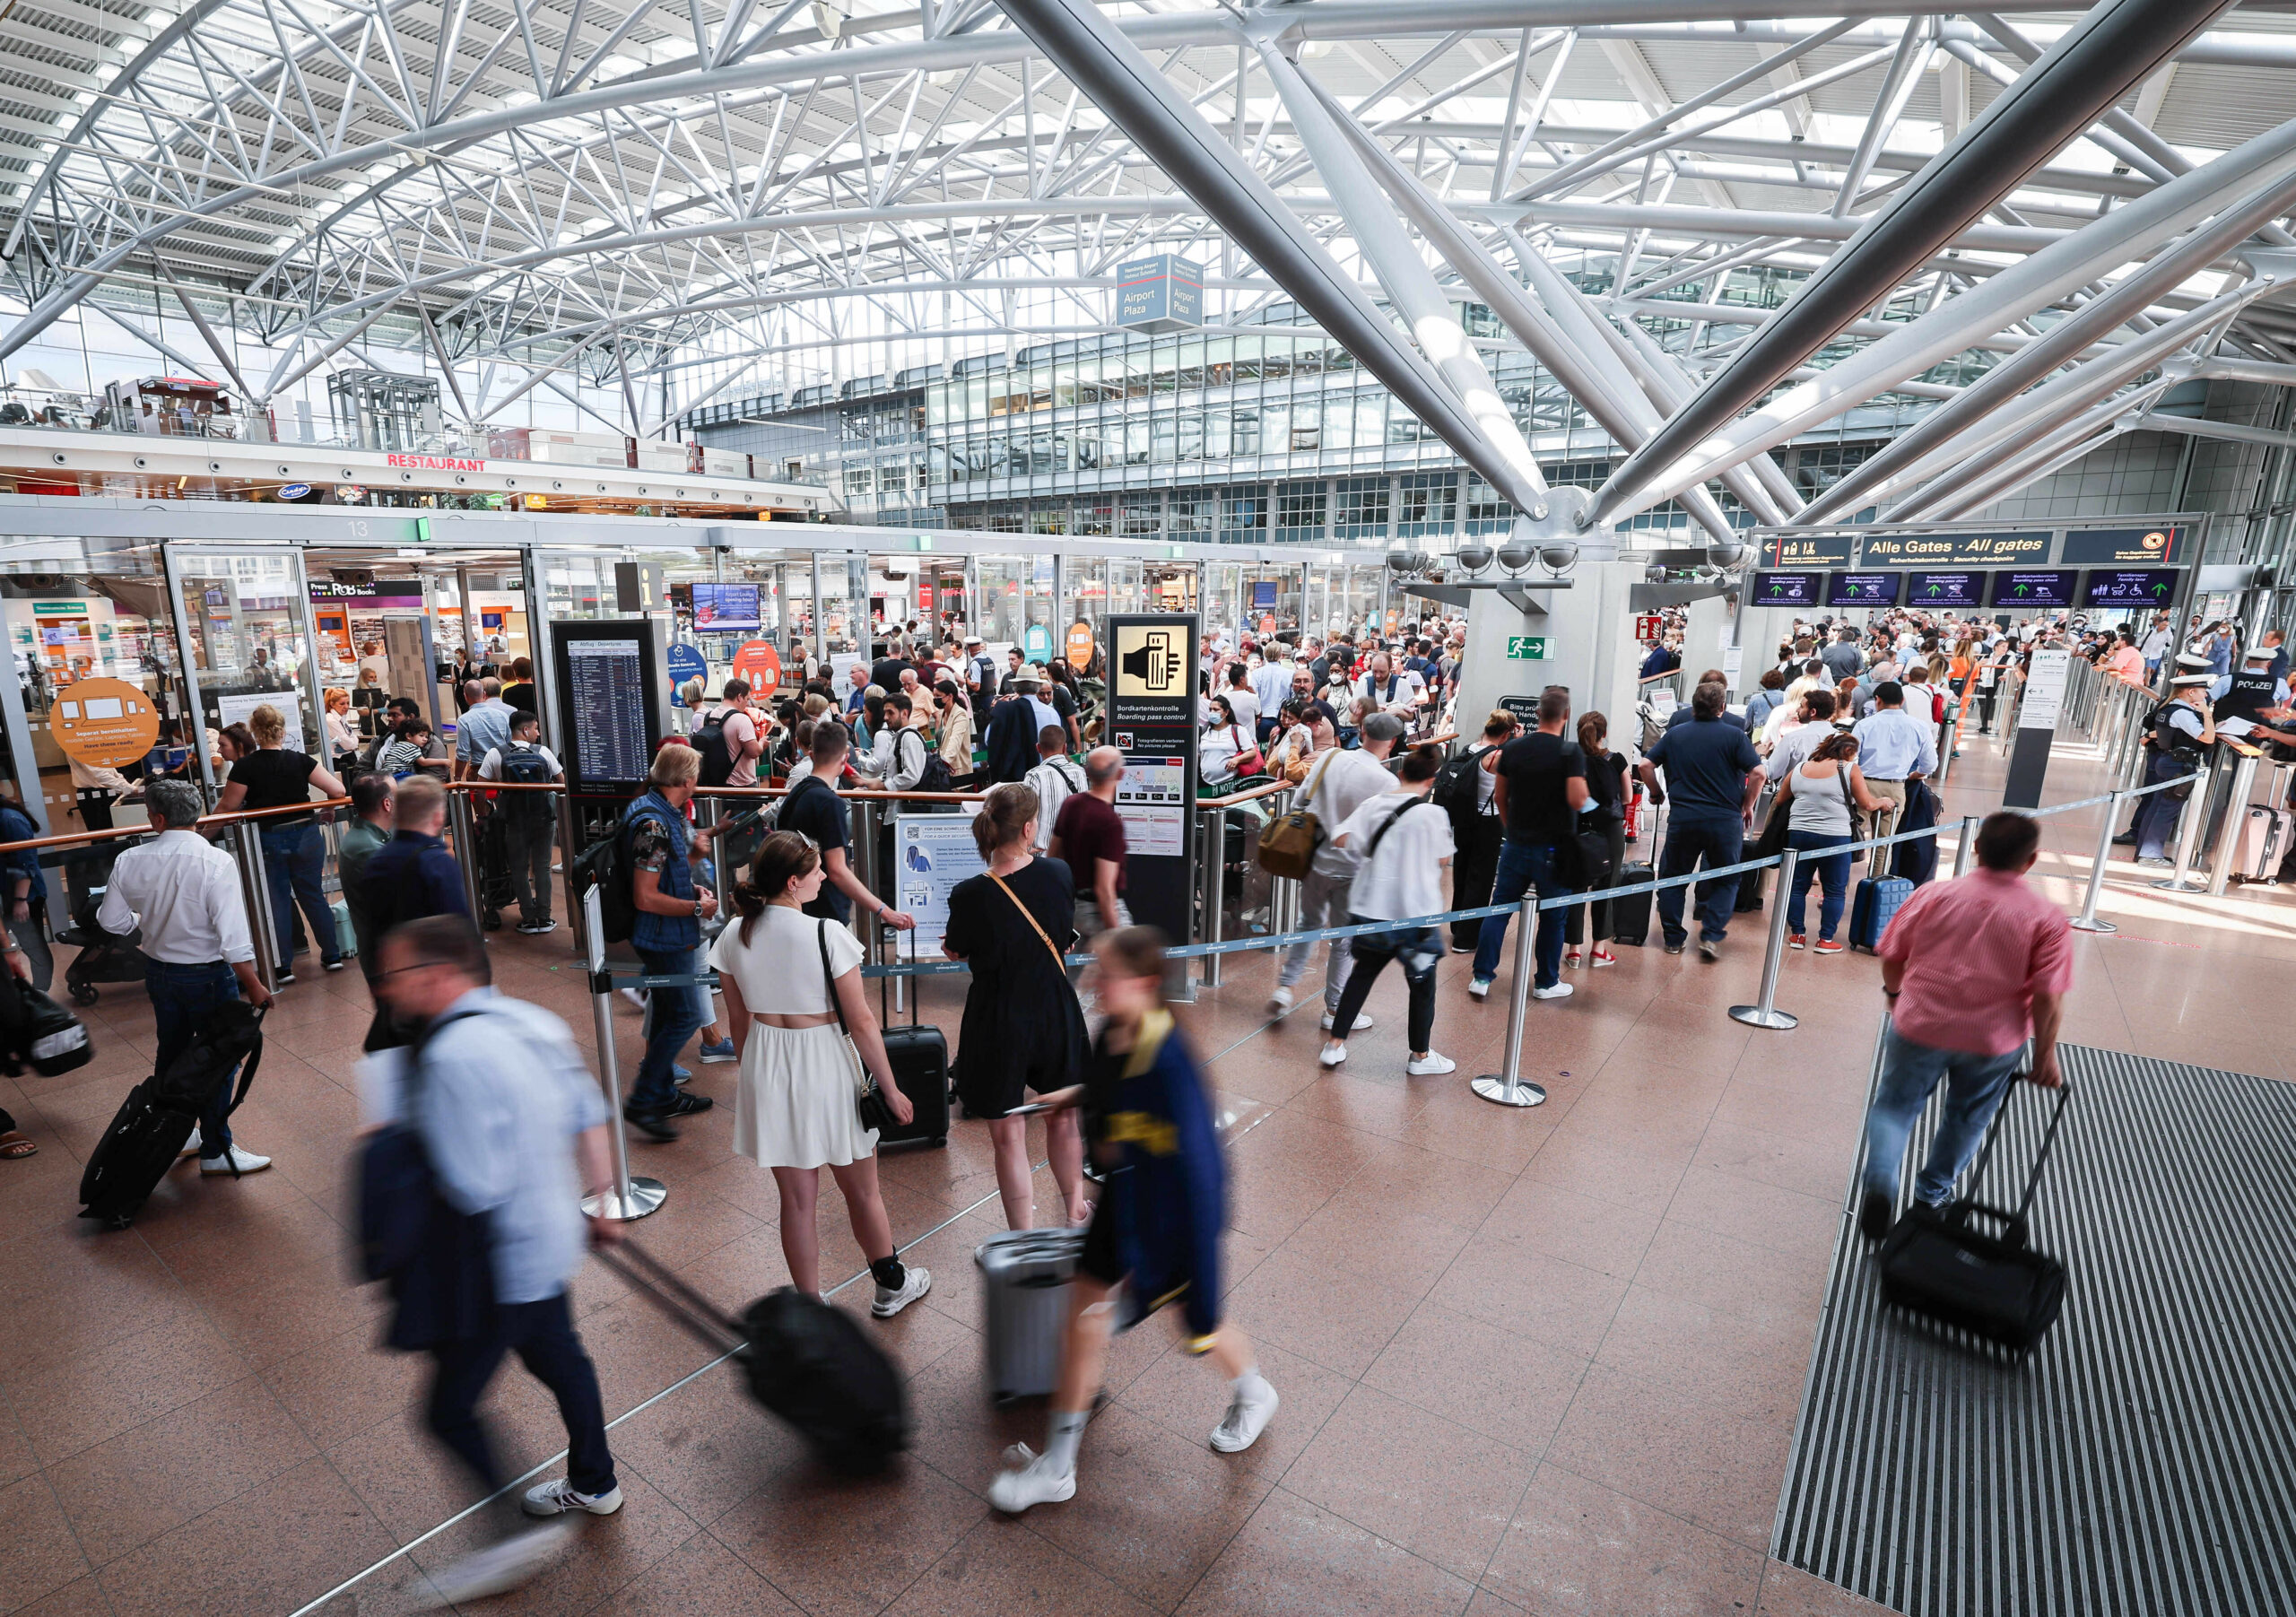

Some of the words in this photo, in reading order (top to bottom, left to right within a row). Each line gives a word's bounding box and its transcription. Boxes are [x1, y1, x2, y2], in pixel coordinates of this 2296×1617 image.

[1124, 290, 1155, 303] Airport
[1174, 288, 1194, 303] Airport
[1124, 306, 1146, 316] Plaza
[1174, 301, 1189, 314] Plaza
[387, 454, 485, 472] RESTAURANT
[348, 521, 368, 536] 13
[1869, 541, 1901, 554] Alle
[1905, 540, 1952, 553] Gates
[1965, 539, 1992, 552] All
[1993, 539, 2043, 554] gates
[642, 568, 652, 605] i
[2238, 681, 2273, 690] POLIZEI
